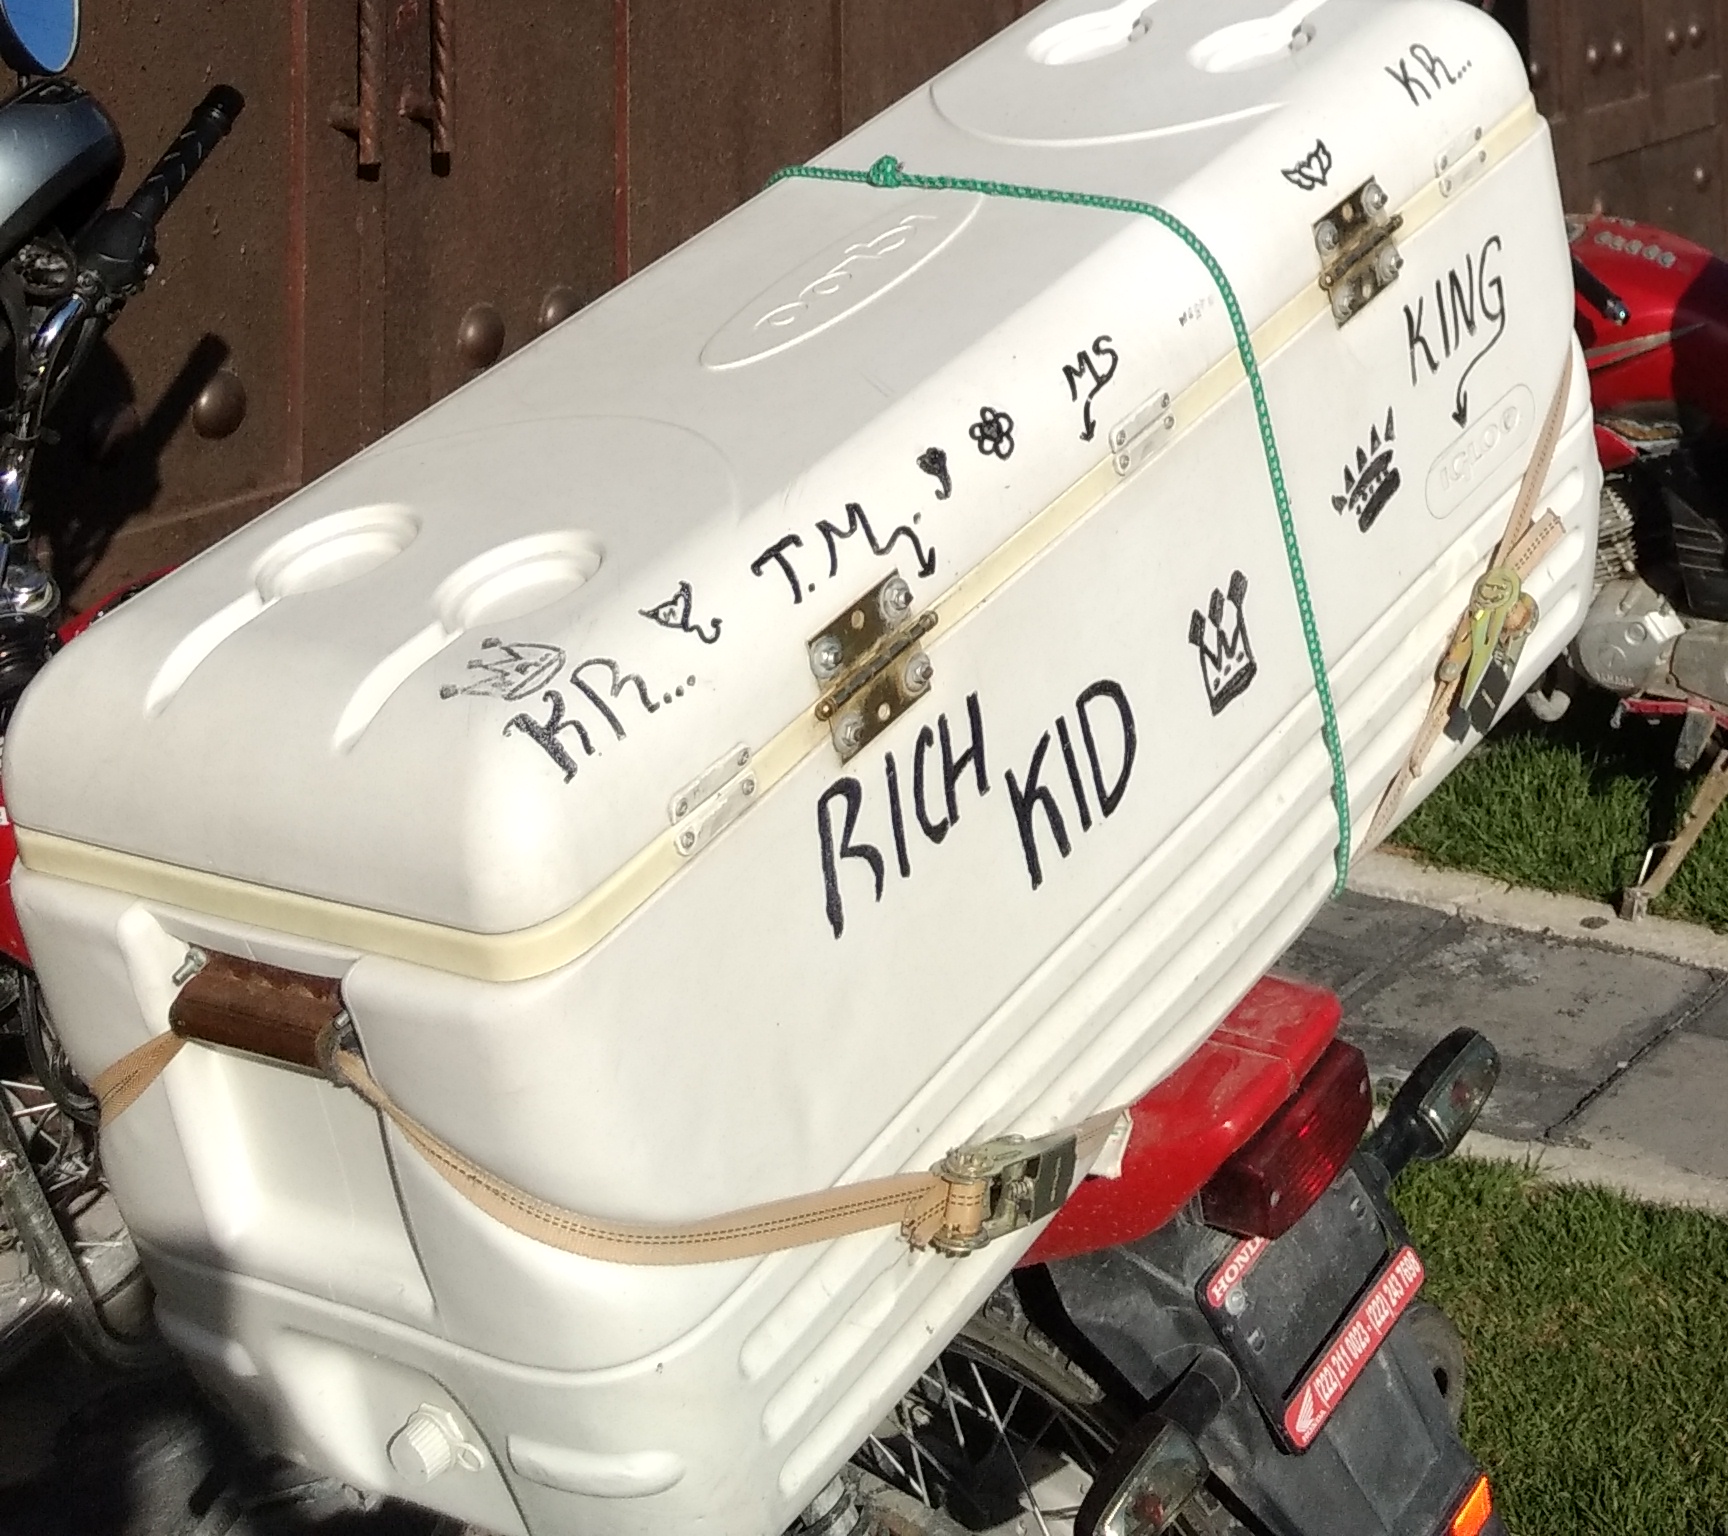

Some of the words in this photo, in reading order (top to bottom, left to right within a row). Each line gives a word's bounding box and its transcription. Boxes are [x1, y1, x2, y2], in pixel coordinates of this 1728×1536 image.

[1402, 234, 1506, 388] KING
[816, 690, 991, 940] RICH
[1003, 678, 1137, 892] KID
[1312, 1362, 1344, 1409] (222)
[1330, 1343, 1354, 1380] 211
[1343, 1320, 1371, 1360] 0023
[1365, 1291, 1395, 1336] (222)
[1382, 1272, 1405, 1308] 243
